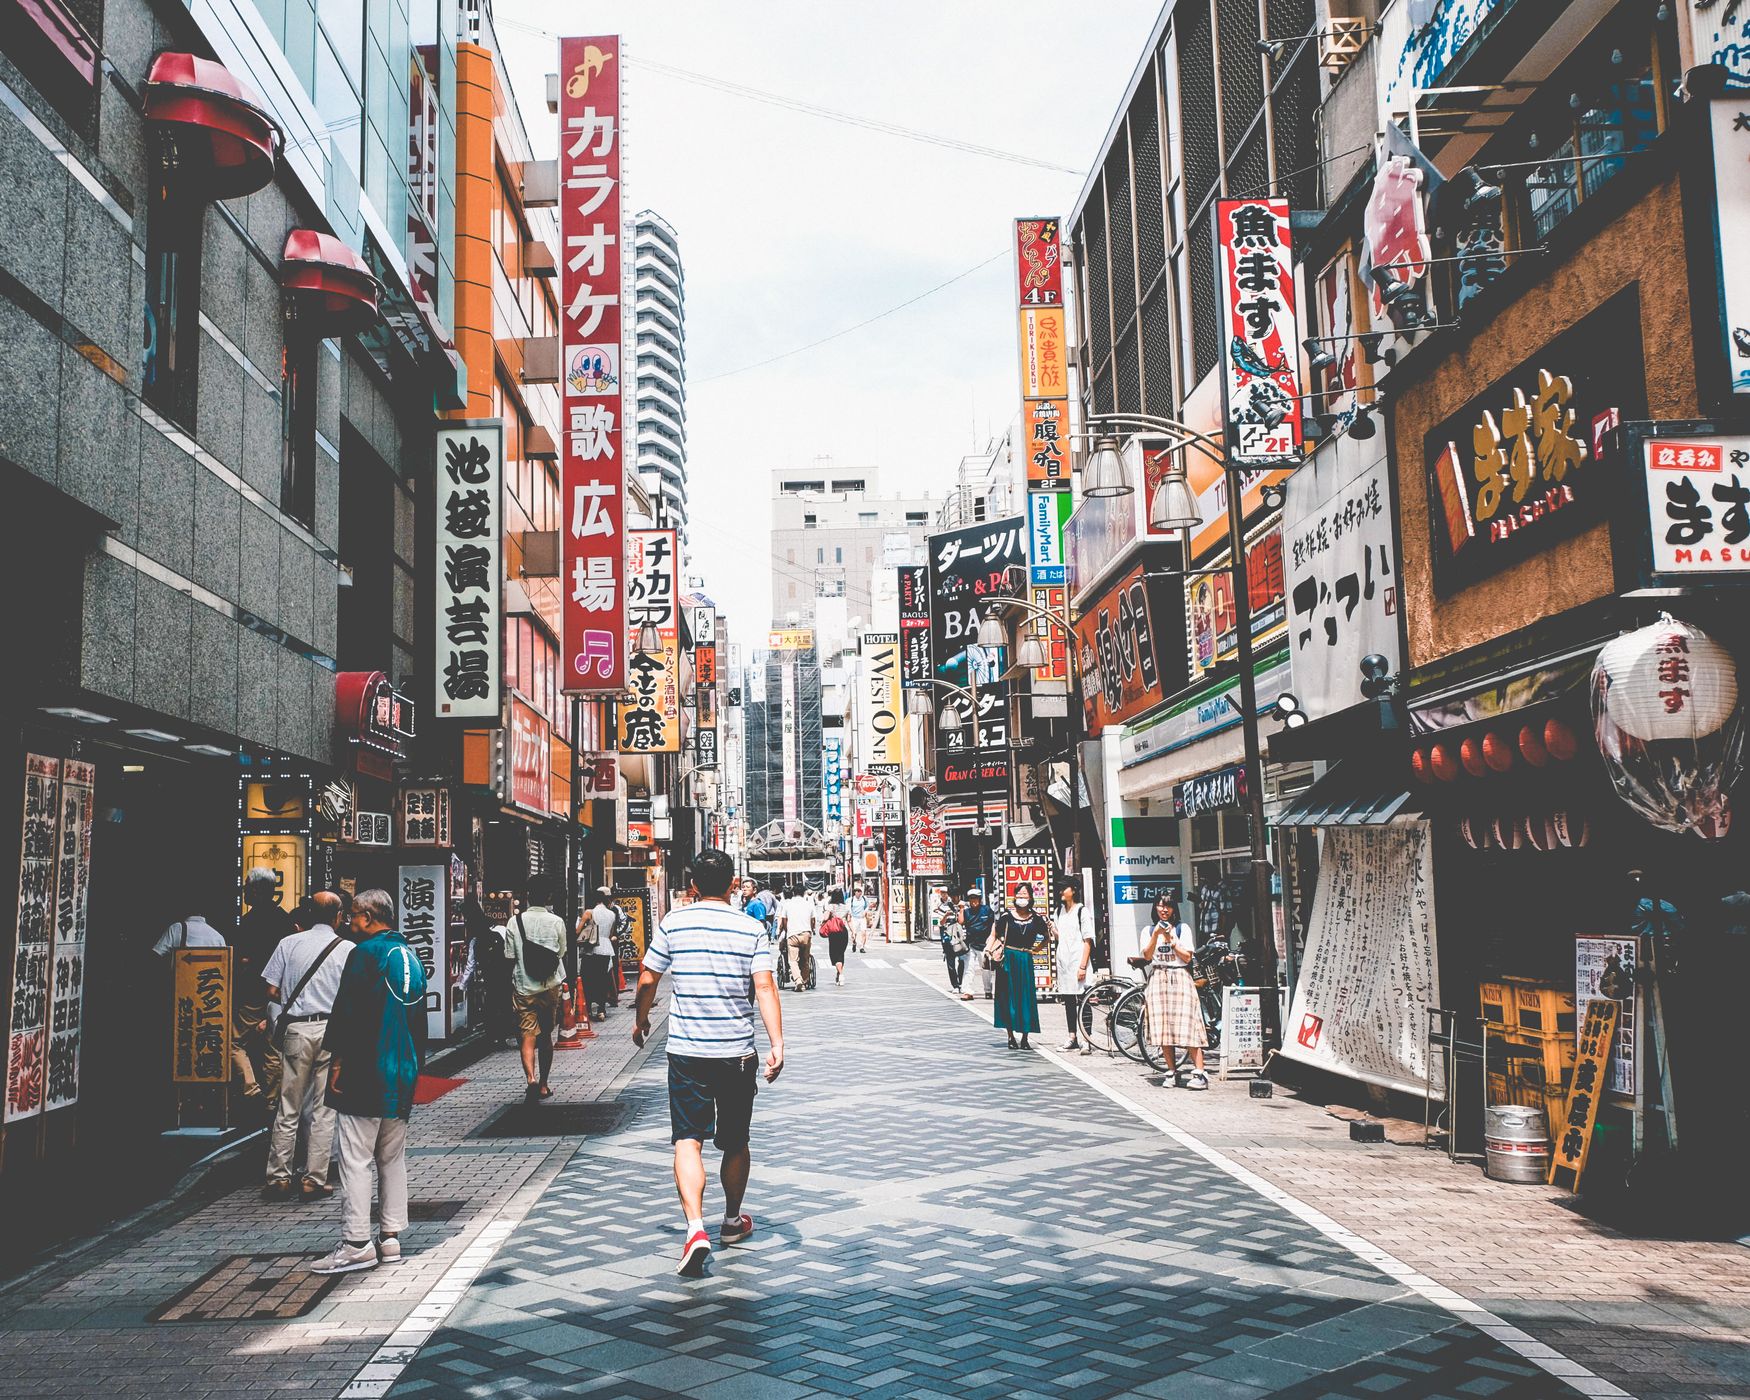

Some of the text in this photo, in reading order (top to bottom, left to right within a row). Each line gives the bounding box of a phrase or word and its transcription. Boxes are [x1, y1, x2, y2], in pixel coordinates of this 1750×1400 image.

[567, 106, 618, 338] カラオケ
[1230, 204, 1281, 340] 魚ます
[1028, 316, 1036, 385] TORIKIZOKU
[1039, 316, 1060, 386] 鳥貴族
[1033, 420, 1064, 477] 腹八分目
[1264, 437, 1290, 452] 2F
[1041, 480, 1056, 488] 2F
[568, 404, 617, 612] 歌広場
[1038, 496, 1050, 563] FamilyMart
[444, 436, 491, 700] 池袋演芸場
[645, 537, 671, 624] チカラ
[974, 580, 986, 595] &
[1037, 570, 1064, 580] 酒 たば
[904, 581, 912, 607] PARTY
[914, 568, 925, 611] ダーツバー
[1036, 591, 1045, 599] 24
[866, 634, 898, 643] HOTEL
[920, 629, 929, 678] インターネット
[664, 646, 675, 706] きんくら酒場
[621, 652, 666, 750] 金の蔵
[784, 698, 793, 734] 大黒屋
[871, 648, 896, 760] WEST ONE
[1197, 693, 1231, 724] FamilyMart
[513, 709, 549, 783] カラオケ
[949, 732, 963, 747] 24
[587, 758, 617, 793] 酒
[945, 766, 968, 781] GRAN
[1005, 866, 1046, 881] DVD
[1119, 855, 1175, 866] FamilyMart
[1122, 886, 1138, 900] 酒
[402, 877, 441, 1013] 演芸場口
[1520, 993, 1541, 1009] KIRIN
